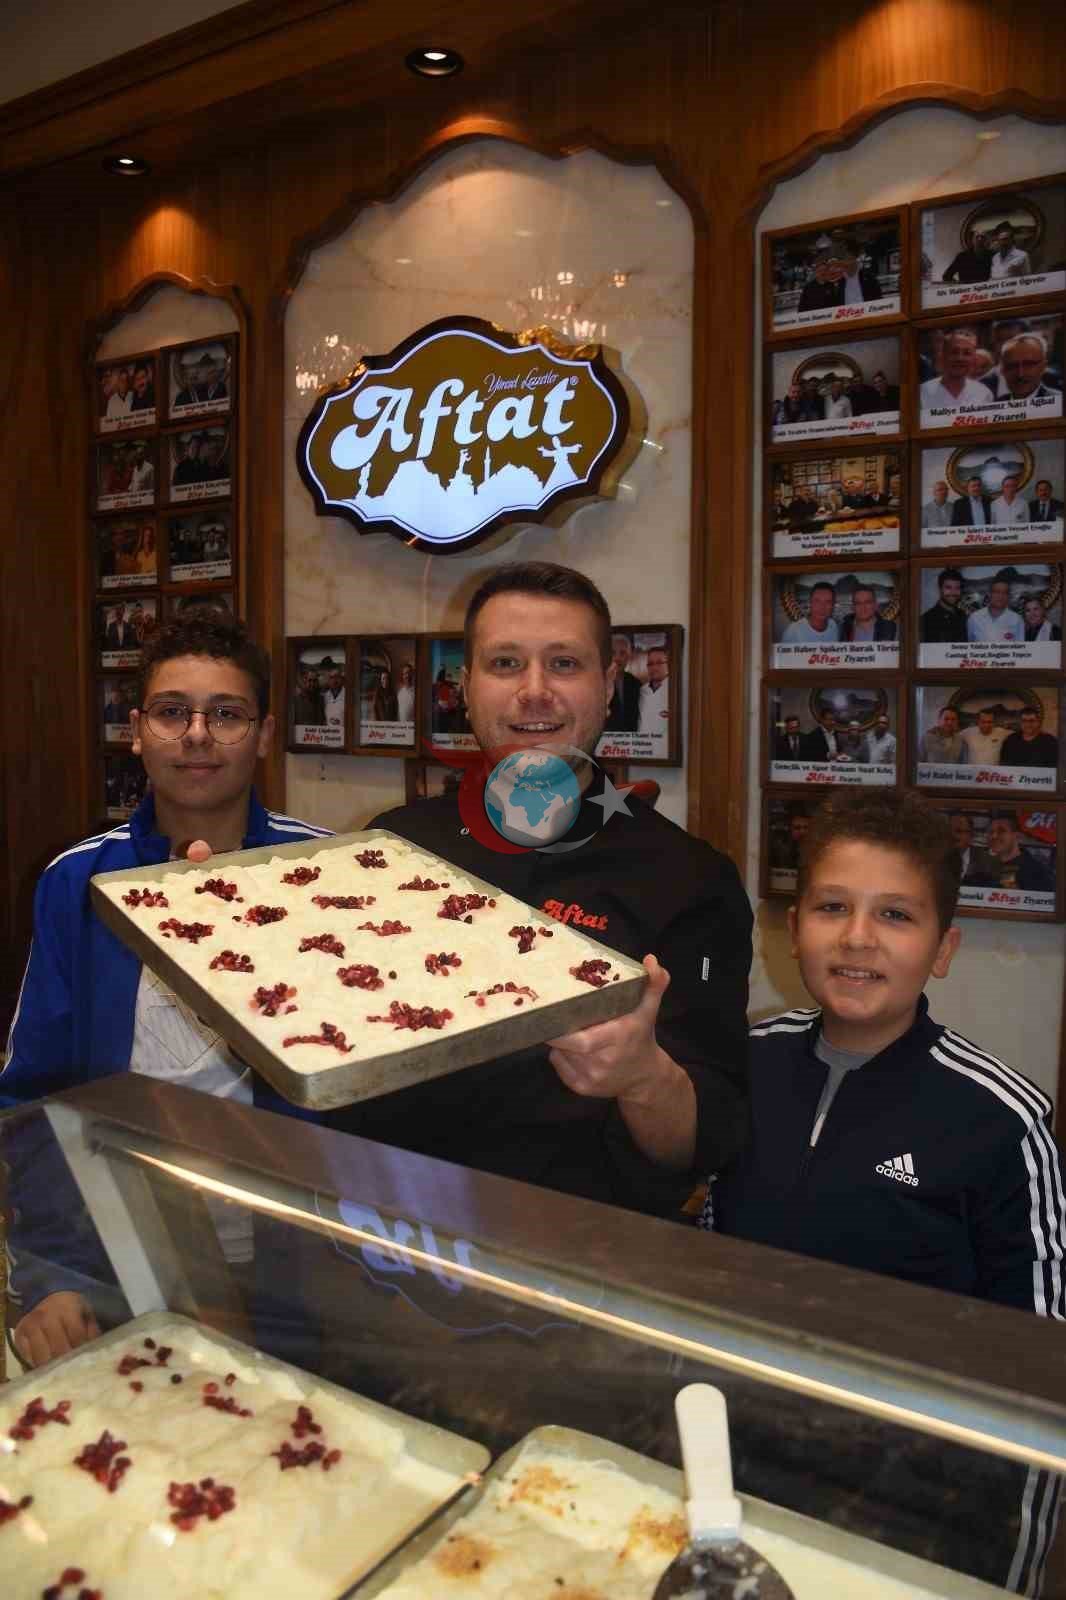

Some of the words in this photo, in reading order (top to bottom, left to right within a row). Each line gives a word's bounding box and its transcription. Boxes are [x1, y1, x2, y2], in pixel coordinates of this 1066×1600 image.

[930, 407, 957, 417] Maliye
[330, 376, 577, 471] Aftat
[953, 415, 989, 427] Aftat
[992, 412, 1026, 424] Ziyareti
[964, 534, 993, 545] Aftat
[794, 645, 817, 653] Haber
[819, 645, 848, 654] Spikeri
[808, 654, 841, 666] Aftat
[843, 654, 876, 664] Ziyareti
[960, 659, 988, 669] Aftat
[805, 771, 836, 783] Aftat
[975, 770, 1014, 786] Aftat
[1018, 774, 1053, 785] Ziyareti
[988, 892, 1021, 905] Aftat
[541, 898, 609, 931] Aftat
[875, 1163, 920, 1187] adidas
